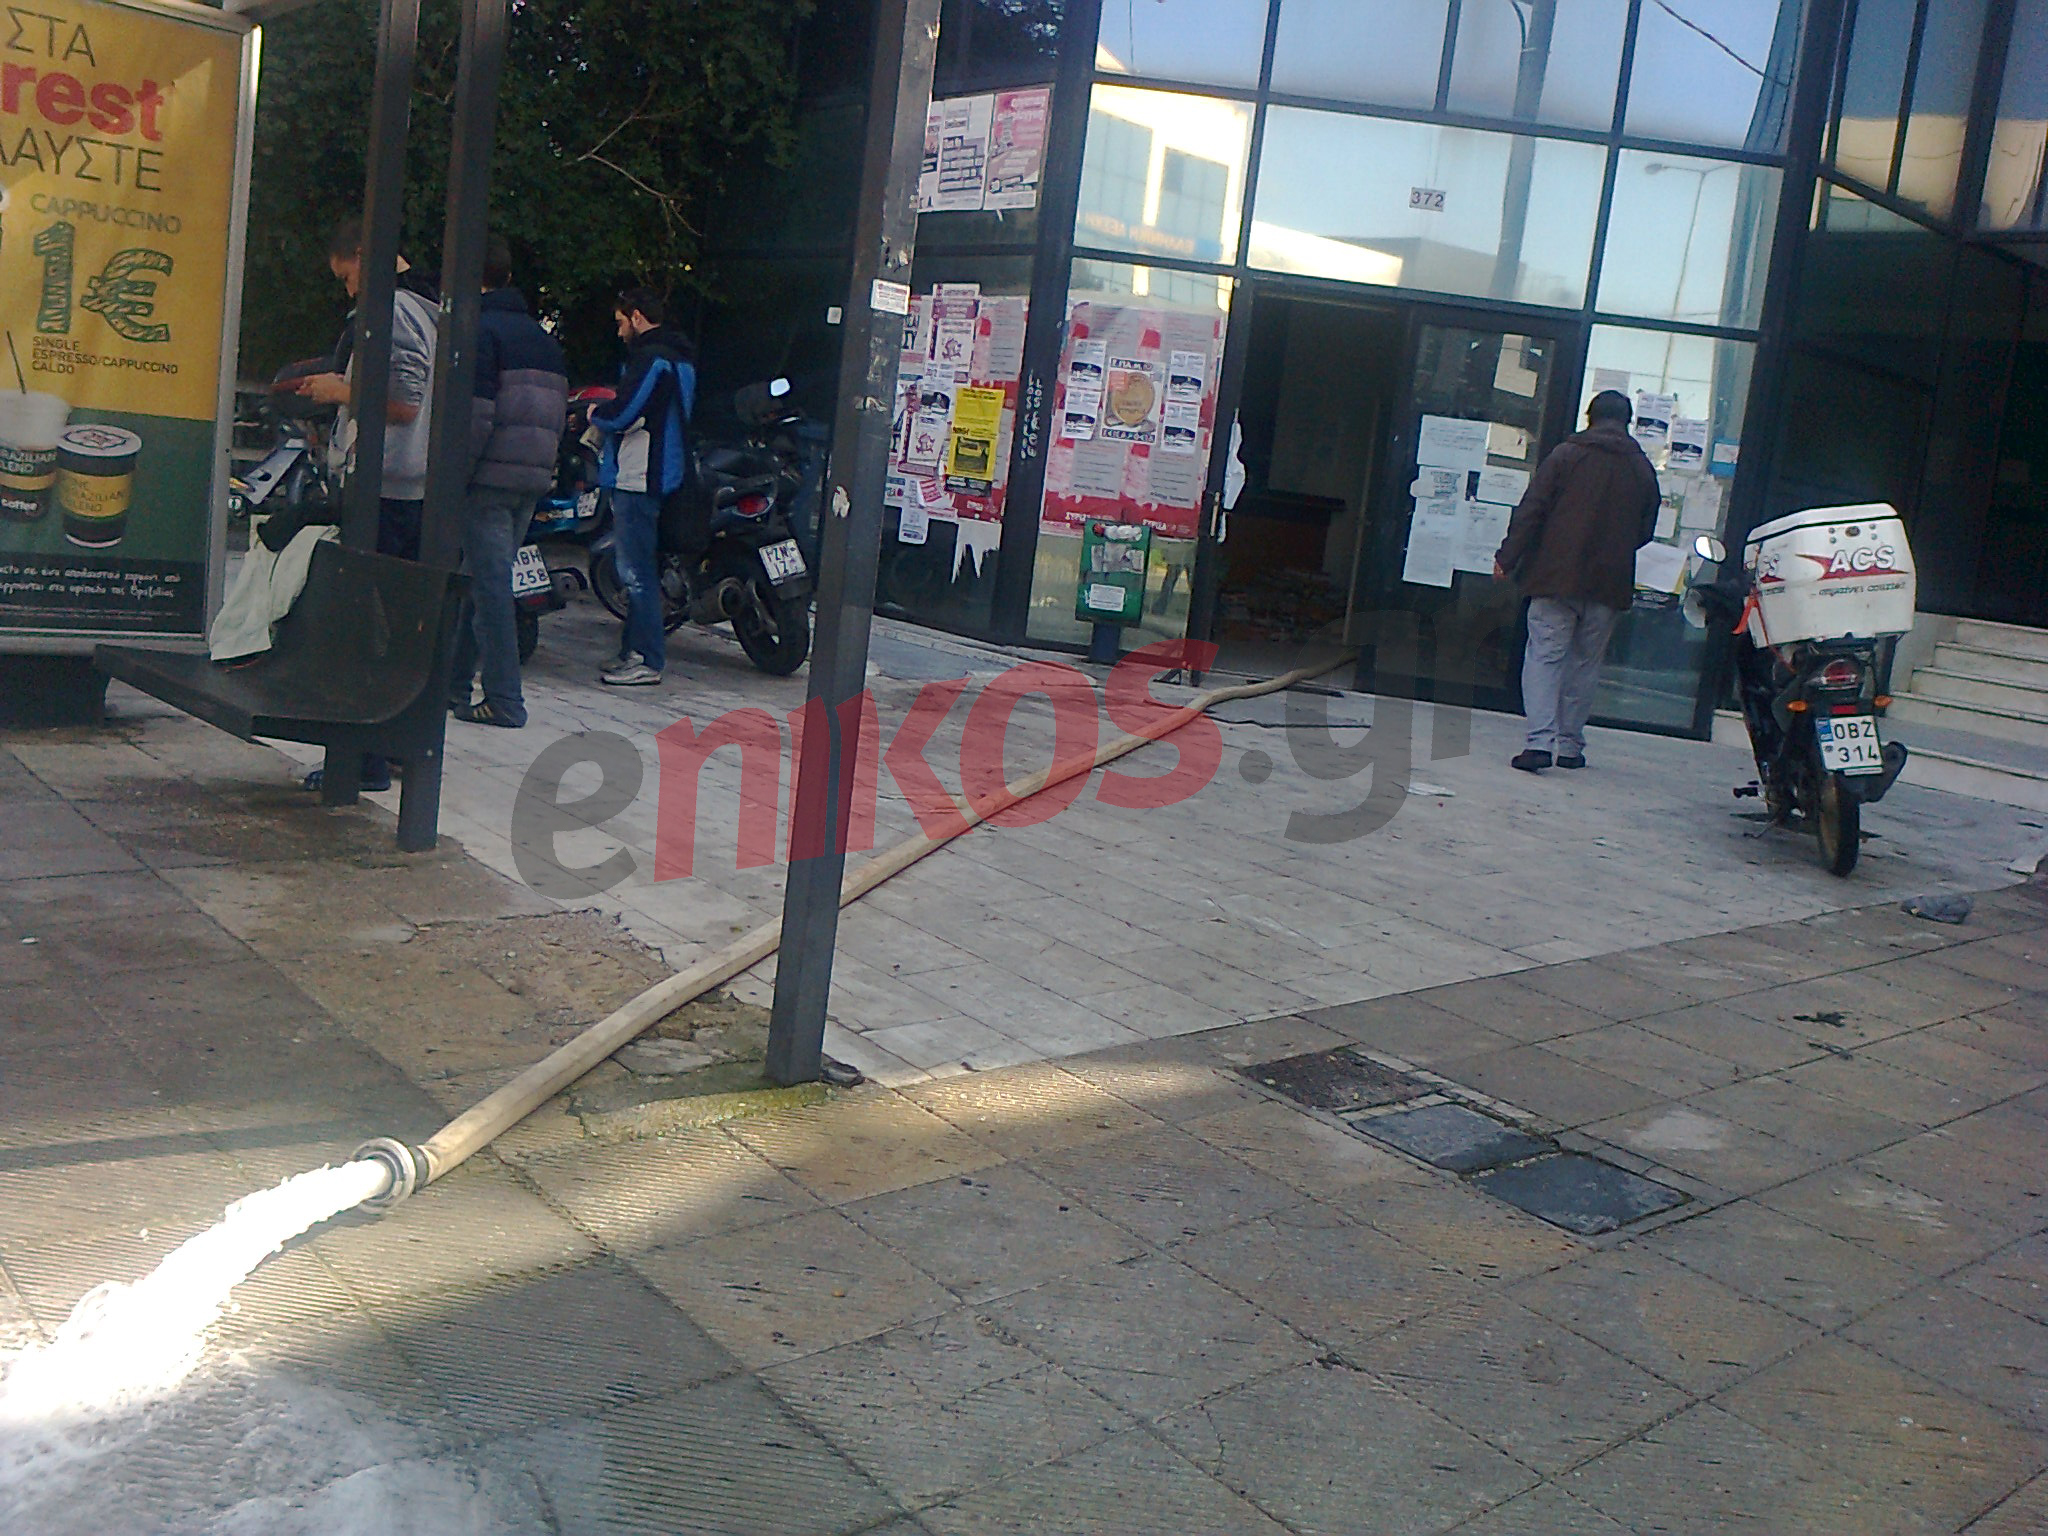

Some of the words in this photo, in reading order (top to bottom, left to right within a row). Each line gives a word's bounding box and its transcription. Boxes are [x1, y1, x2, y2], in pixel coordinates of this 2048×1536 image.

[1411, 191, 1444, 207] 372
[1829, 545, 1895, 573] ACS
[516, 568, 549, 587] 258
[1834, 720, 1876, 739] OBZ
[1838, 744, 1878, 762] 314
